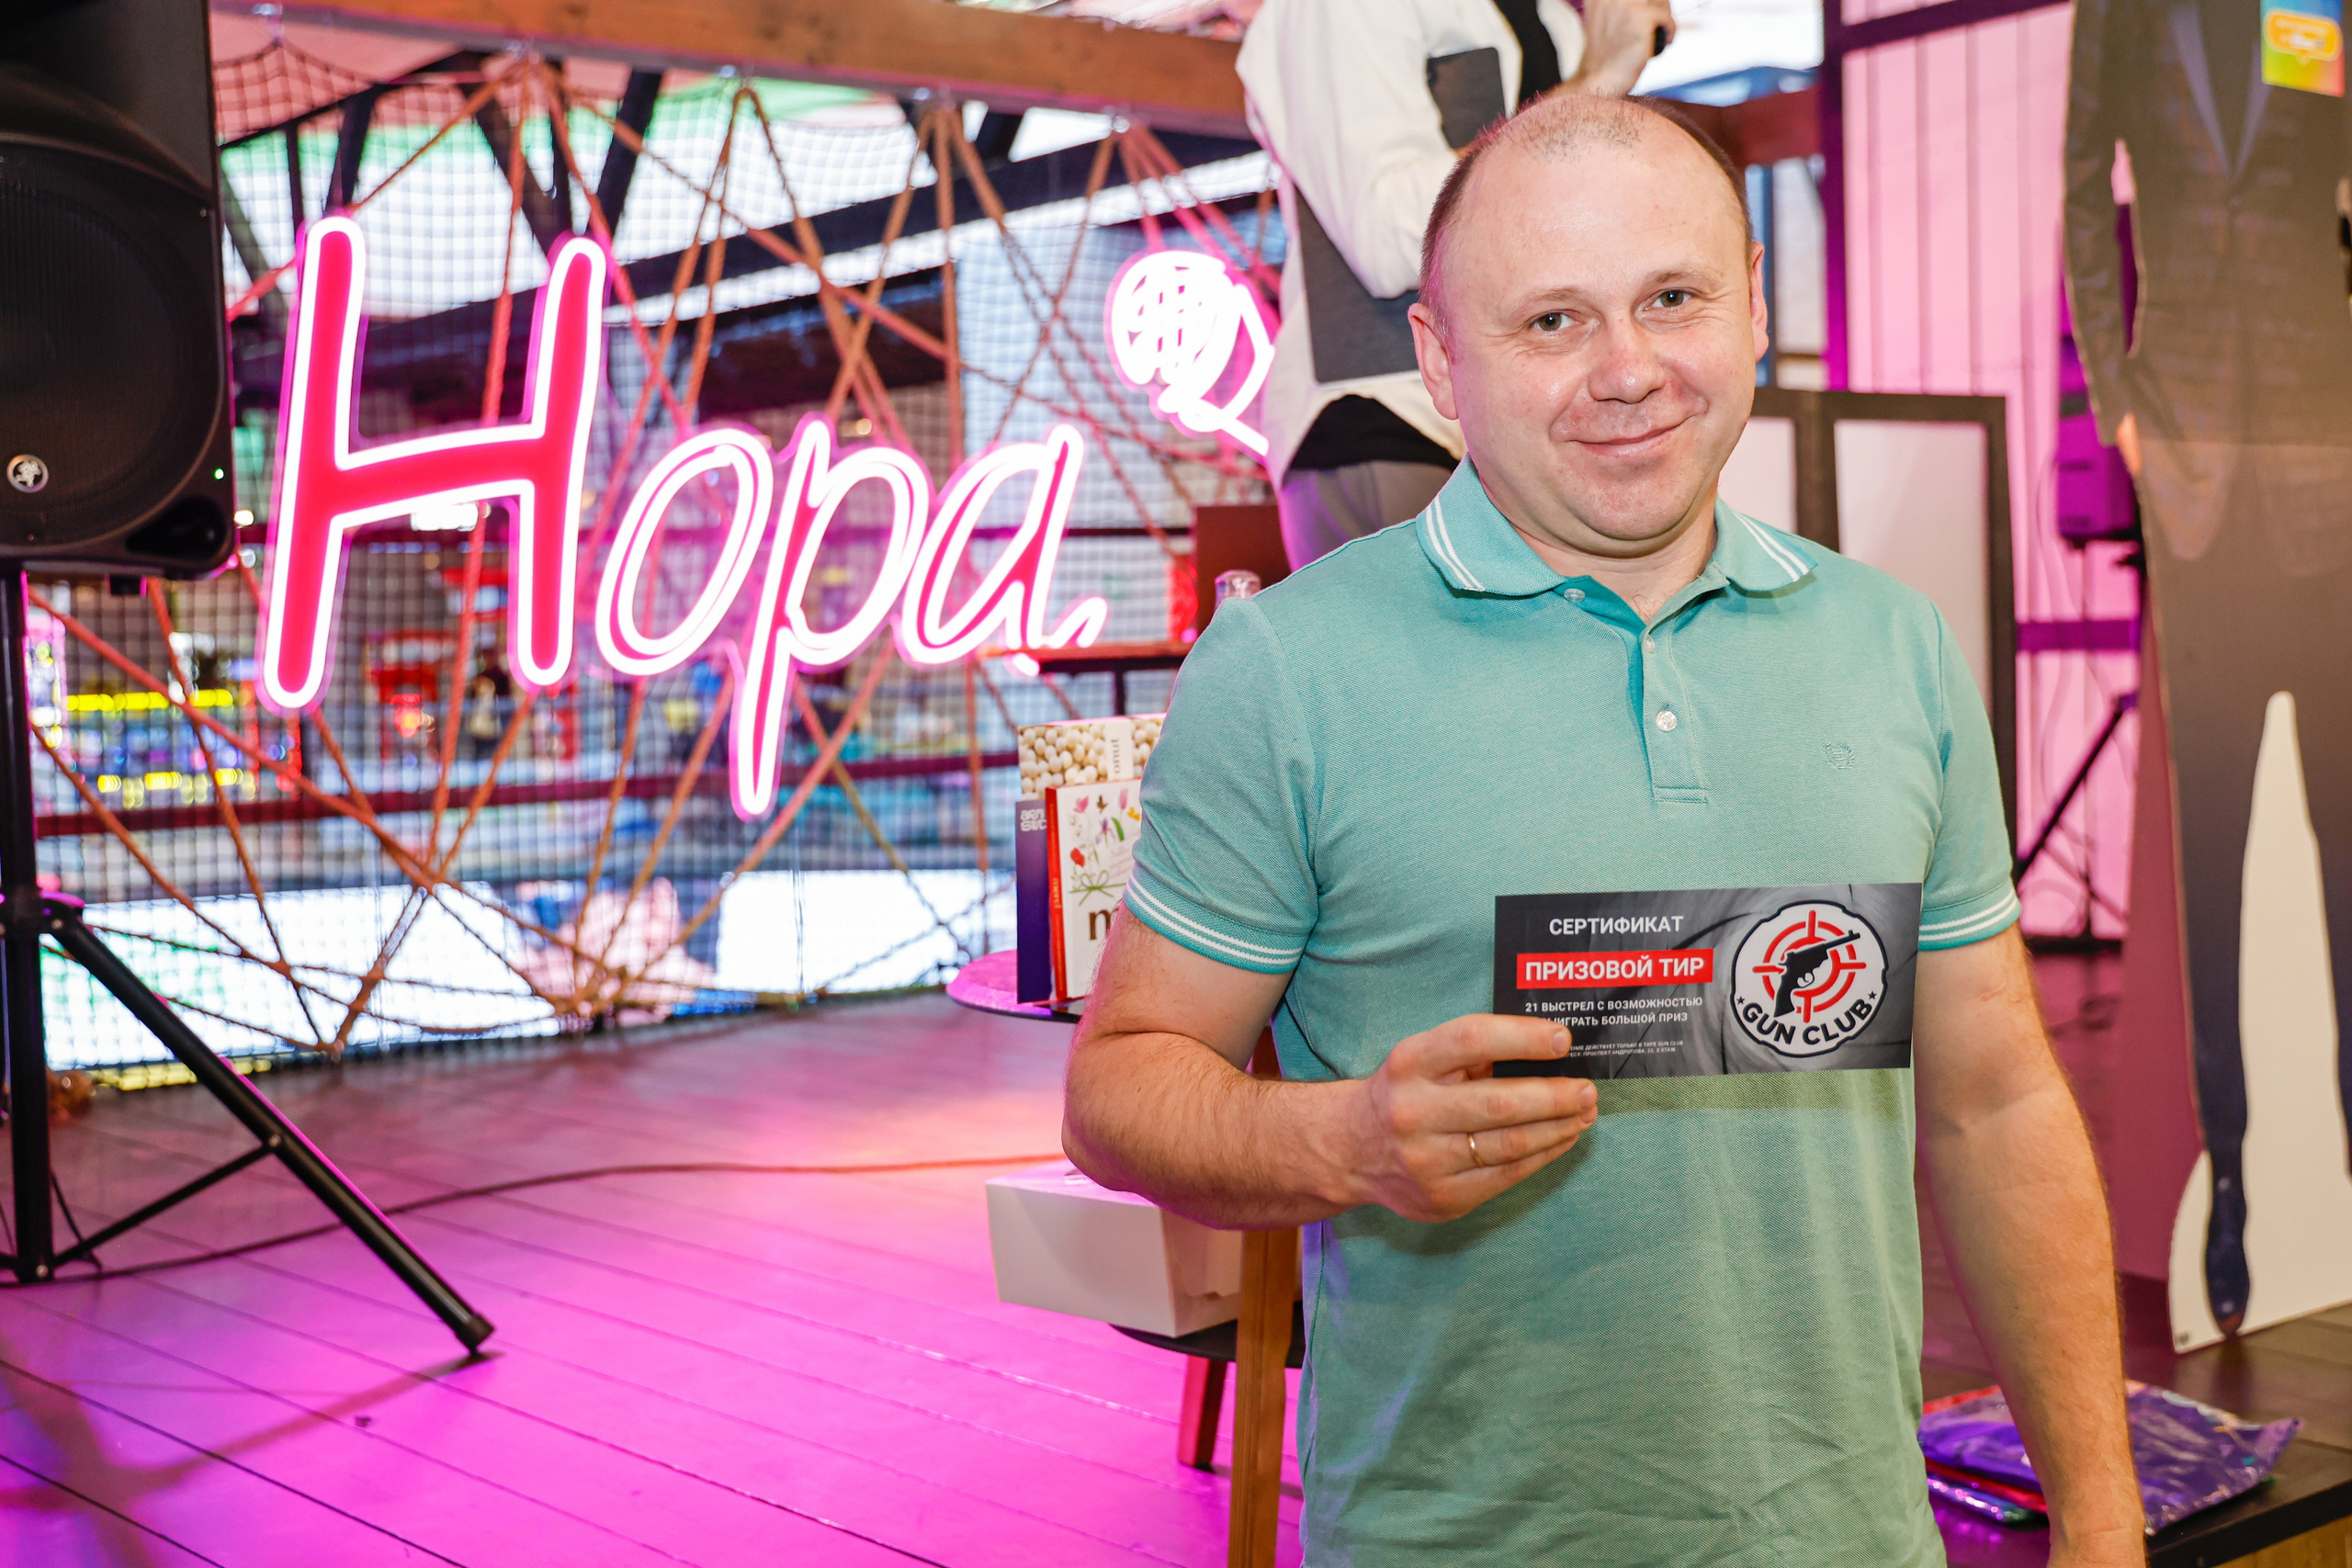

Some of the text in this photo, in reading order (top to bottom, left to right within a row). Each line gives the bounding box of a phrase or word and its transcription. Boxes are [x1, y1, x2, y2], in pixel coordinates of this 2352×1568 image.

[1548, 915, 1684, 935] СЕРТИФИКАТ
[1525, 954, 1704, 981] ПРИЗОВОЙ ТИР
[1525, 997, 1703, 1013] 21 ВЫСТРЕЛ С ВОЗМОЖНОСТЬЮ
[1601, 1011, 1657, 1025] БОЛЬШОЙ
[1658, 1012, 1689, 1023] ПРИЗ
[1742, 998, 1872, 1045] GUN CLUB
